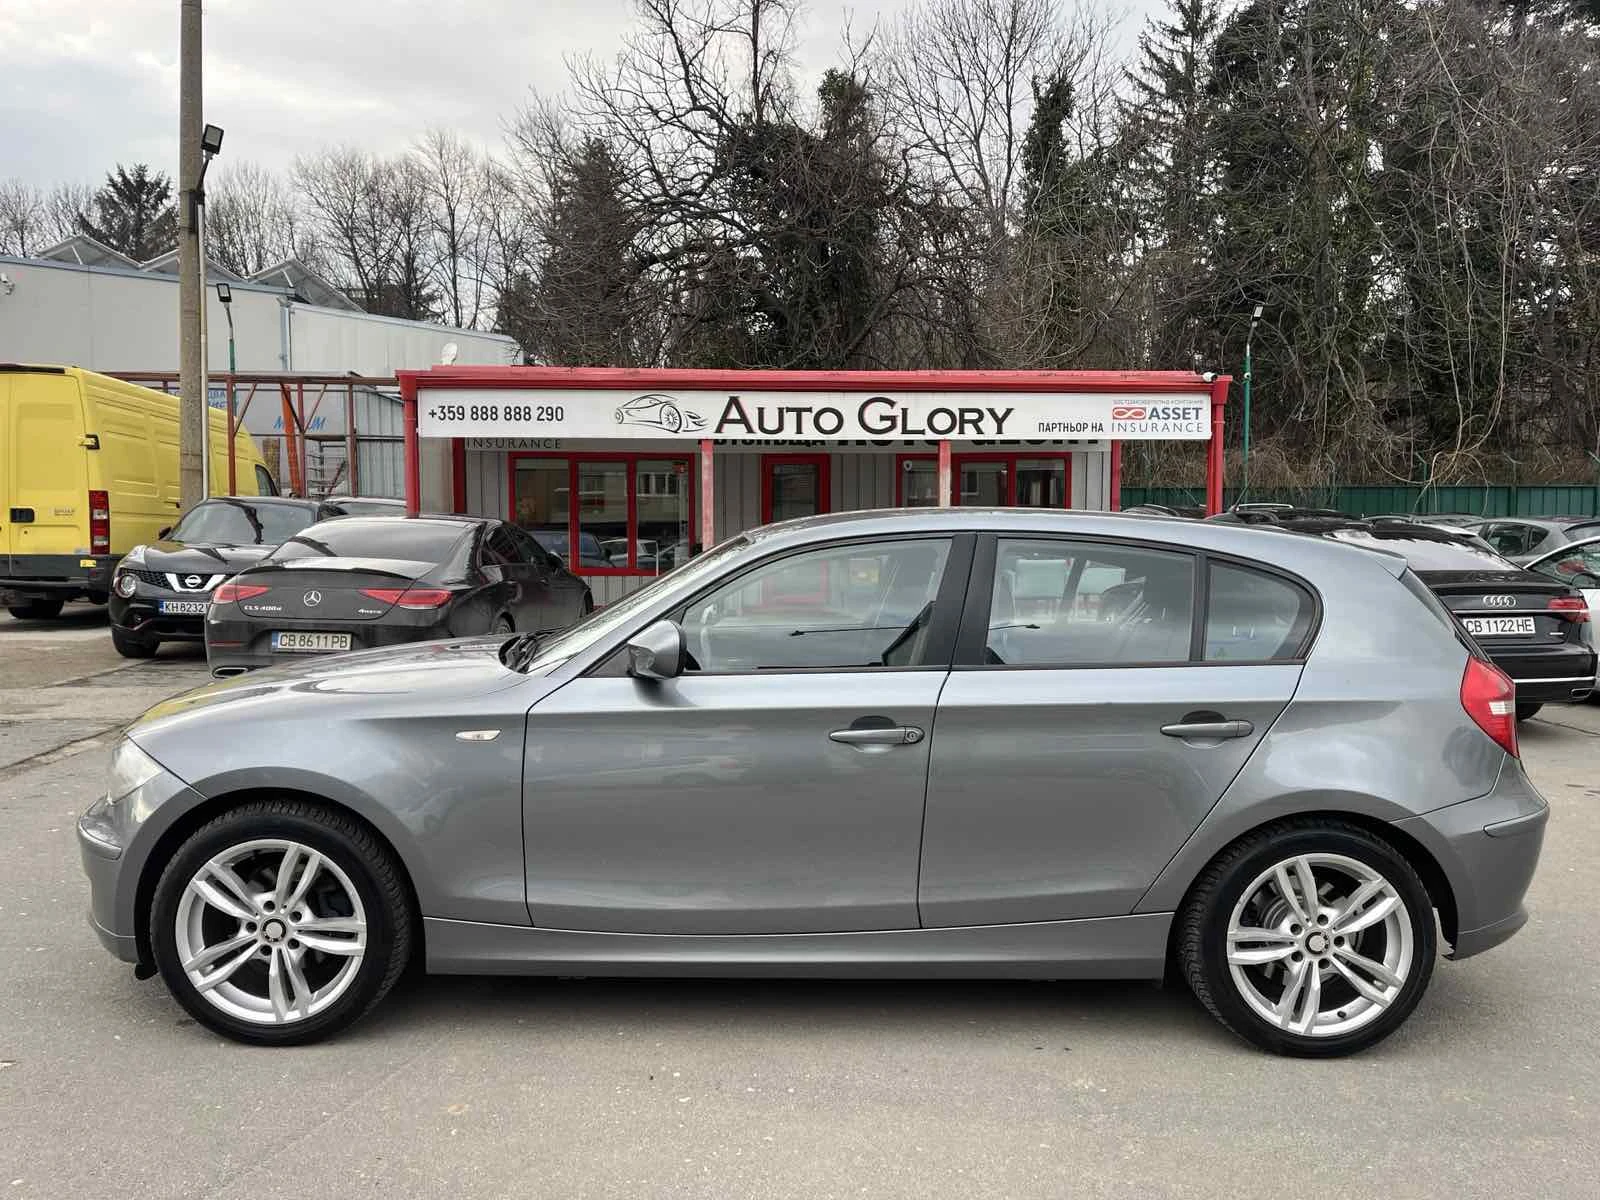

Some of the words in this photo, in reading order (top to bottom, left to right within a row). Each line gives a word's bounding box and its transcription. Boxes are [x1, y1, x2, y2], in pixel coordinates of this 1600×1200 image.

[428, 405, 465, 421] +359
[470, 405, 499, 422] 888
[503, 406, 532, 422] 888
[536, 406, 564, 422] 290
[713, 395, 844, 435] AUTO
[857, 396, 1015, 436] GLORY
[1148, 407, 1203, 421] ASSET
[1038, 422, 1089, 433] ПАРТНЬОР
[1091, 422, 1104, 433] НА
[1111, 422, 1203, 433] INSURANCE
[466, 438, 561, 449] INSURANCE
[1485, 619, 1515, 633] 1122
[298, 635, 328, 648] 8611
